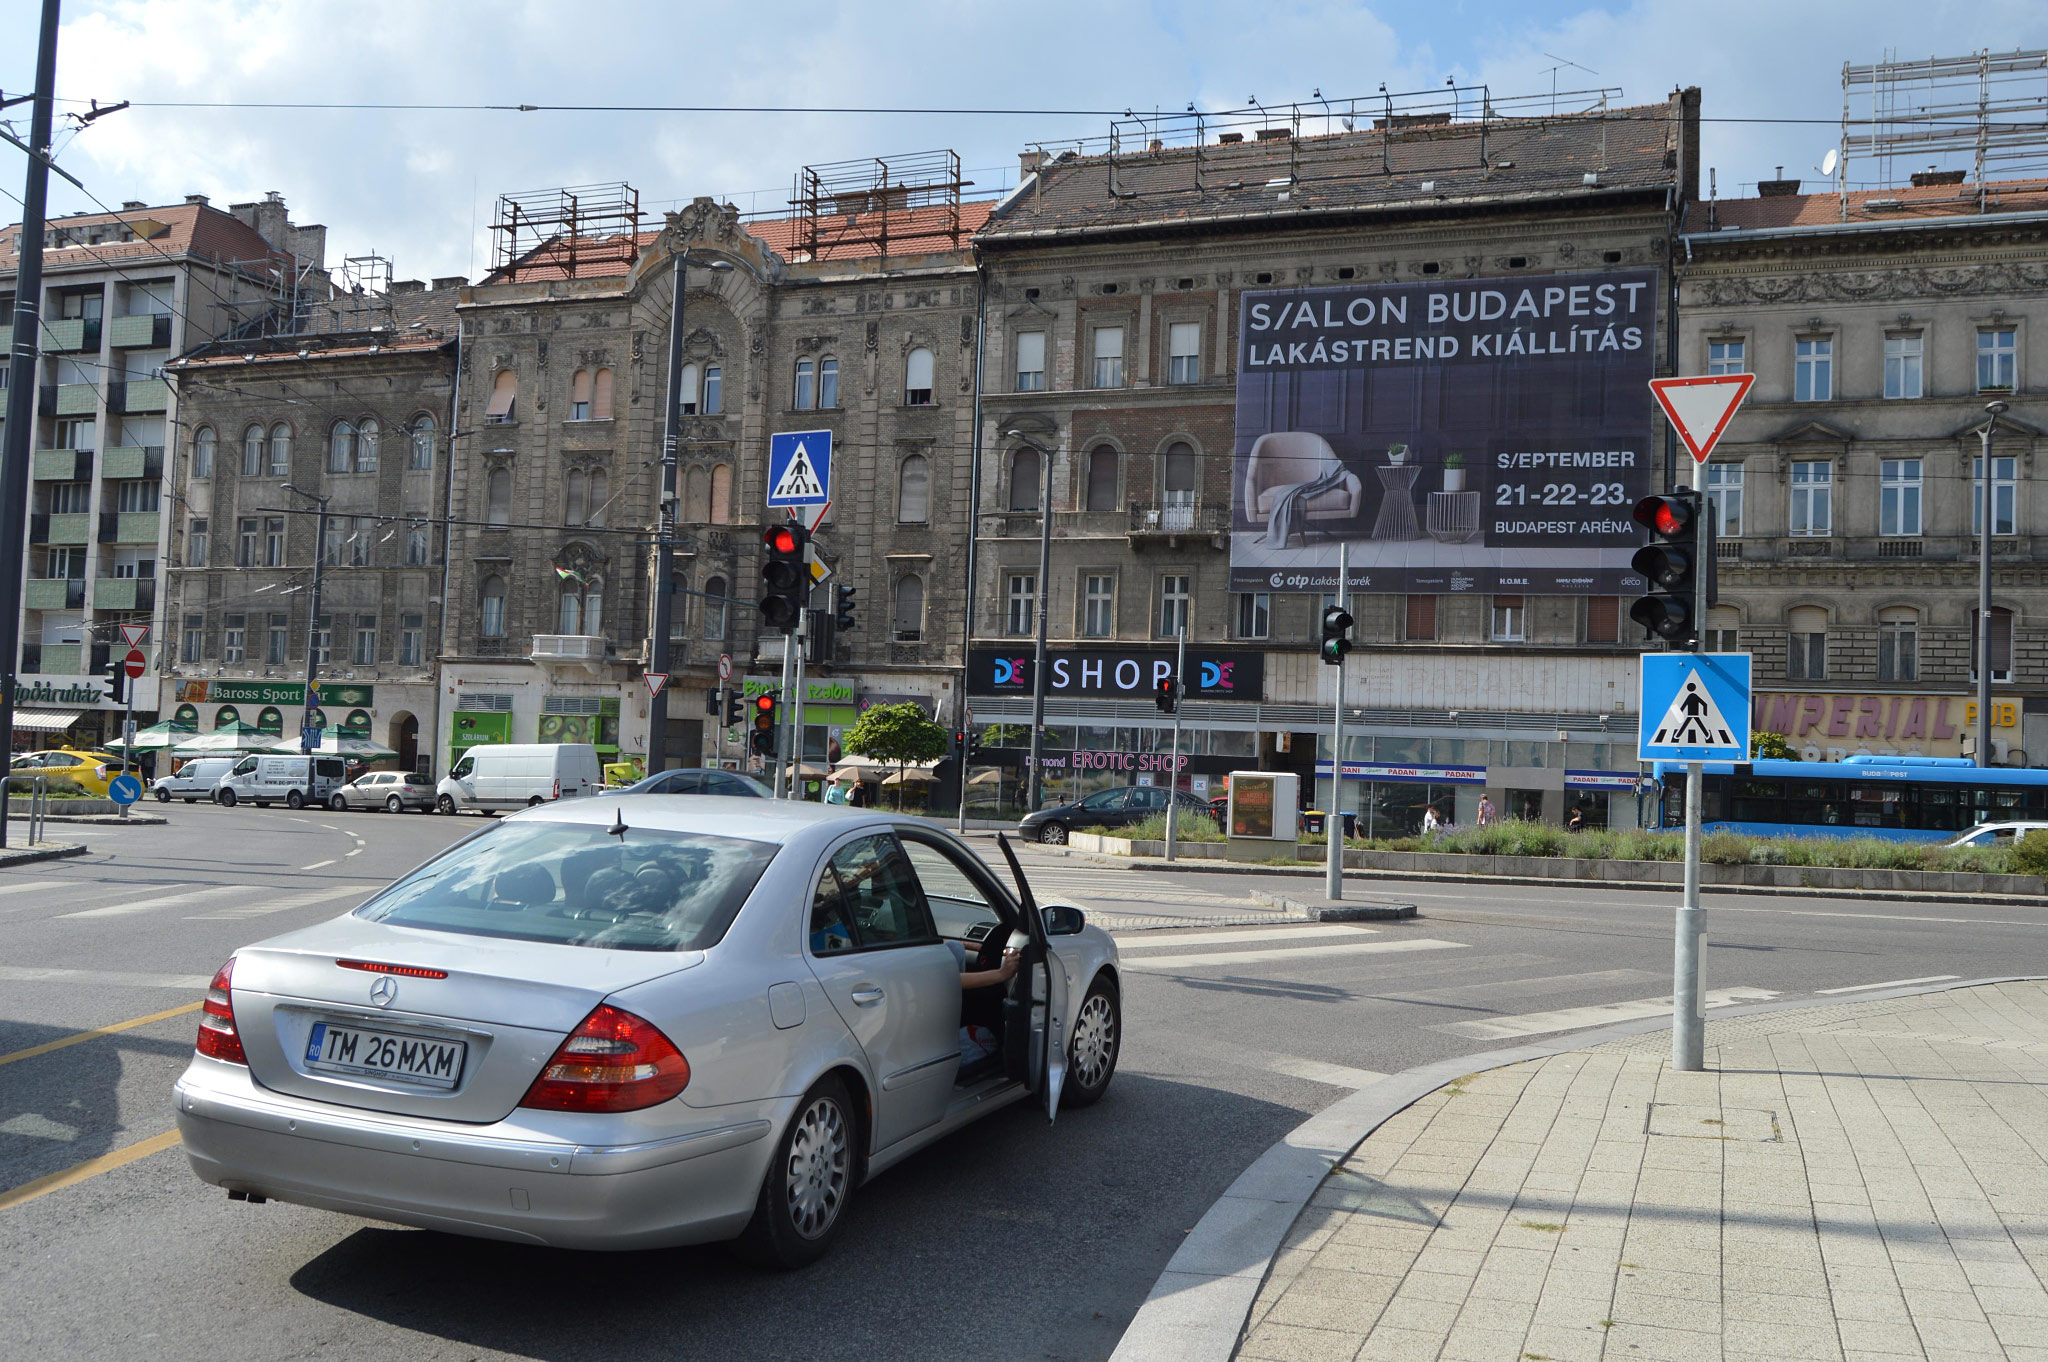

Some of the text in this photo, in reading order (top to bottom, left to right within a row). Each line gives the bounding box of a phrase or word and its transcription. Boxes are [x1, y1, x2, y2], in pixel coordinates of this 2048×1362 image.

[1250, 282, 1647, 331] S/ALON BUDAPEST
[1249, 322, 1642, 366] LAKÁSTREND KIÁLLÍTÁS
[1497, 451, 1635, 469] S/EPTEMBER
[1496, 482, 1633, 506] 21-22-23.
[1495, 517, 1633, 534] BUDAPEST ARÉNA
[1287, 574, 1371, 589] otp Lakástkarék
[1052, 658, 1172, 690] SHOP
[15, 681, 102, 706] ipőáruház
[214, 686, 328, 702] Baross Sport ar
[807, 682, 853, 700] szalon
[1755, 695, 1957, 739] IMPERIAL
[1072, 751, 1135, 771] EROTIC
[1138, 753, 1188, 772] SHOP
[1332, 766, 1361, 774] DANI
[1388, 768, 1417, 776] PADANI
[1445, 770, 1475, 778] PADANI
[309, 1029, 455, 1077] RO TM 26 MXM
